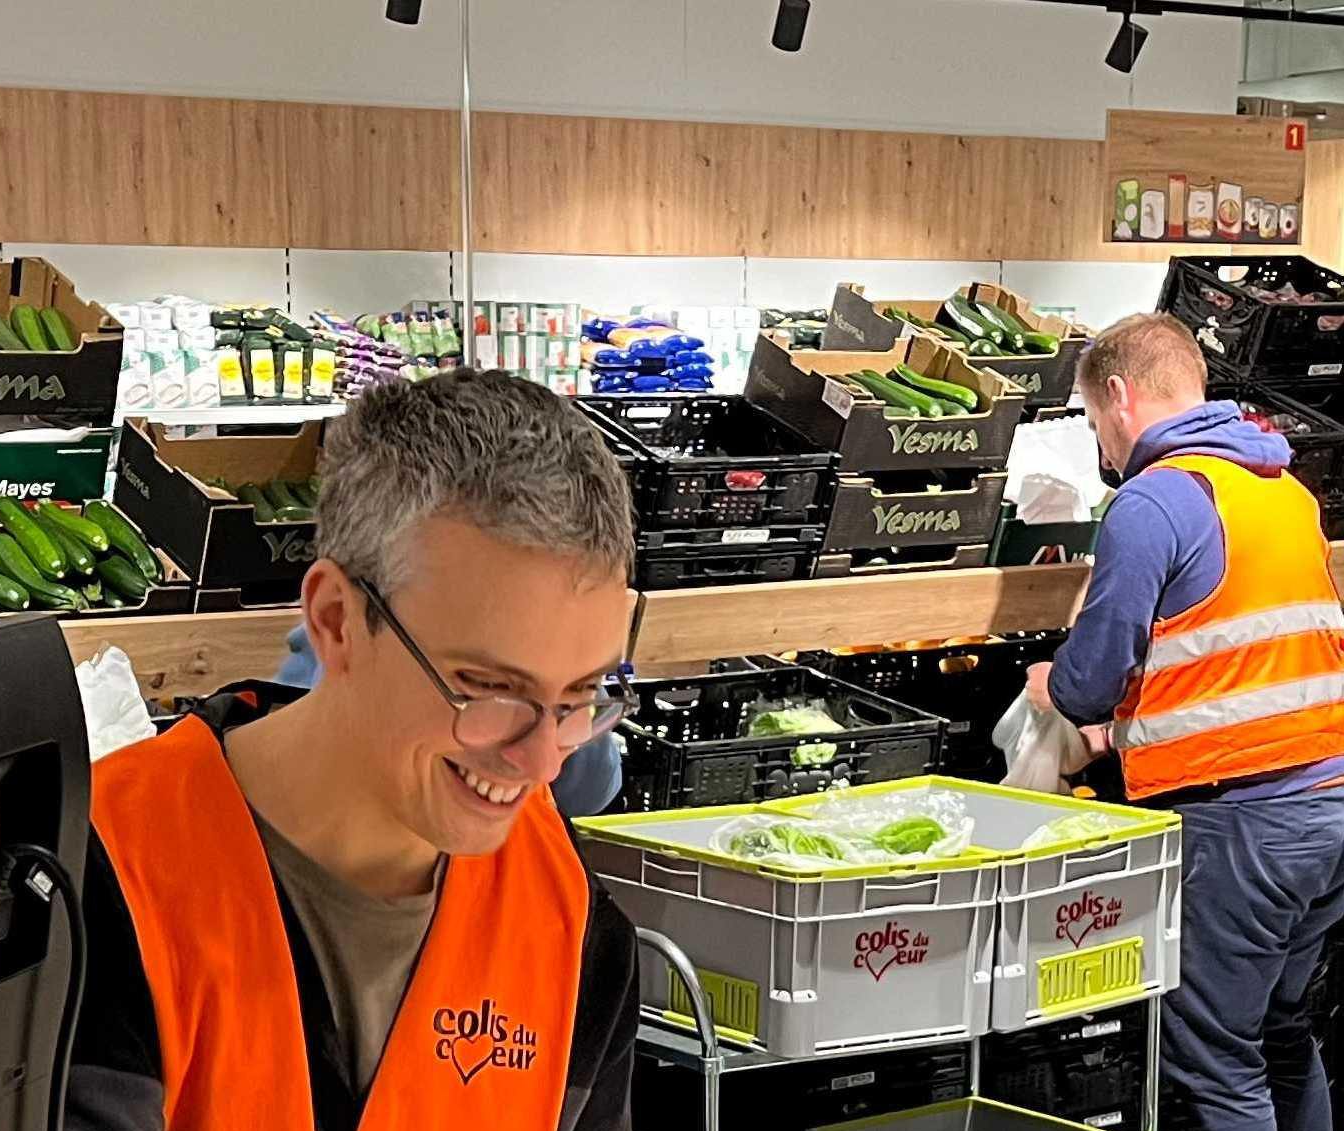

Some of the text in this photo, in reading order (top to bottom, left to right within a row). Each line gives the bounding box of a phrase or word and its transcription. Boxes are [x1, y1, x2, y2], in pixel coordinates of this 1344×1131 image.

[1289, 126, 1299, 146] 1
[887, 422, 979, 454] Yesma
[872, 503, 961, 535] Yesma
[263, 529, 318, 563] Yes
[1056, 891, 1122, 923] colis du
[855, 921, 929, 952] colis du
[433, 999, 537, 1047] colis du
